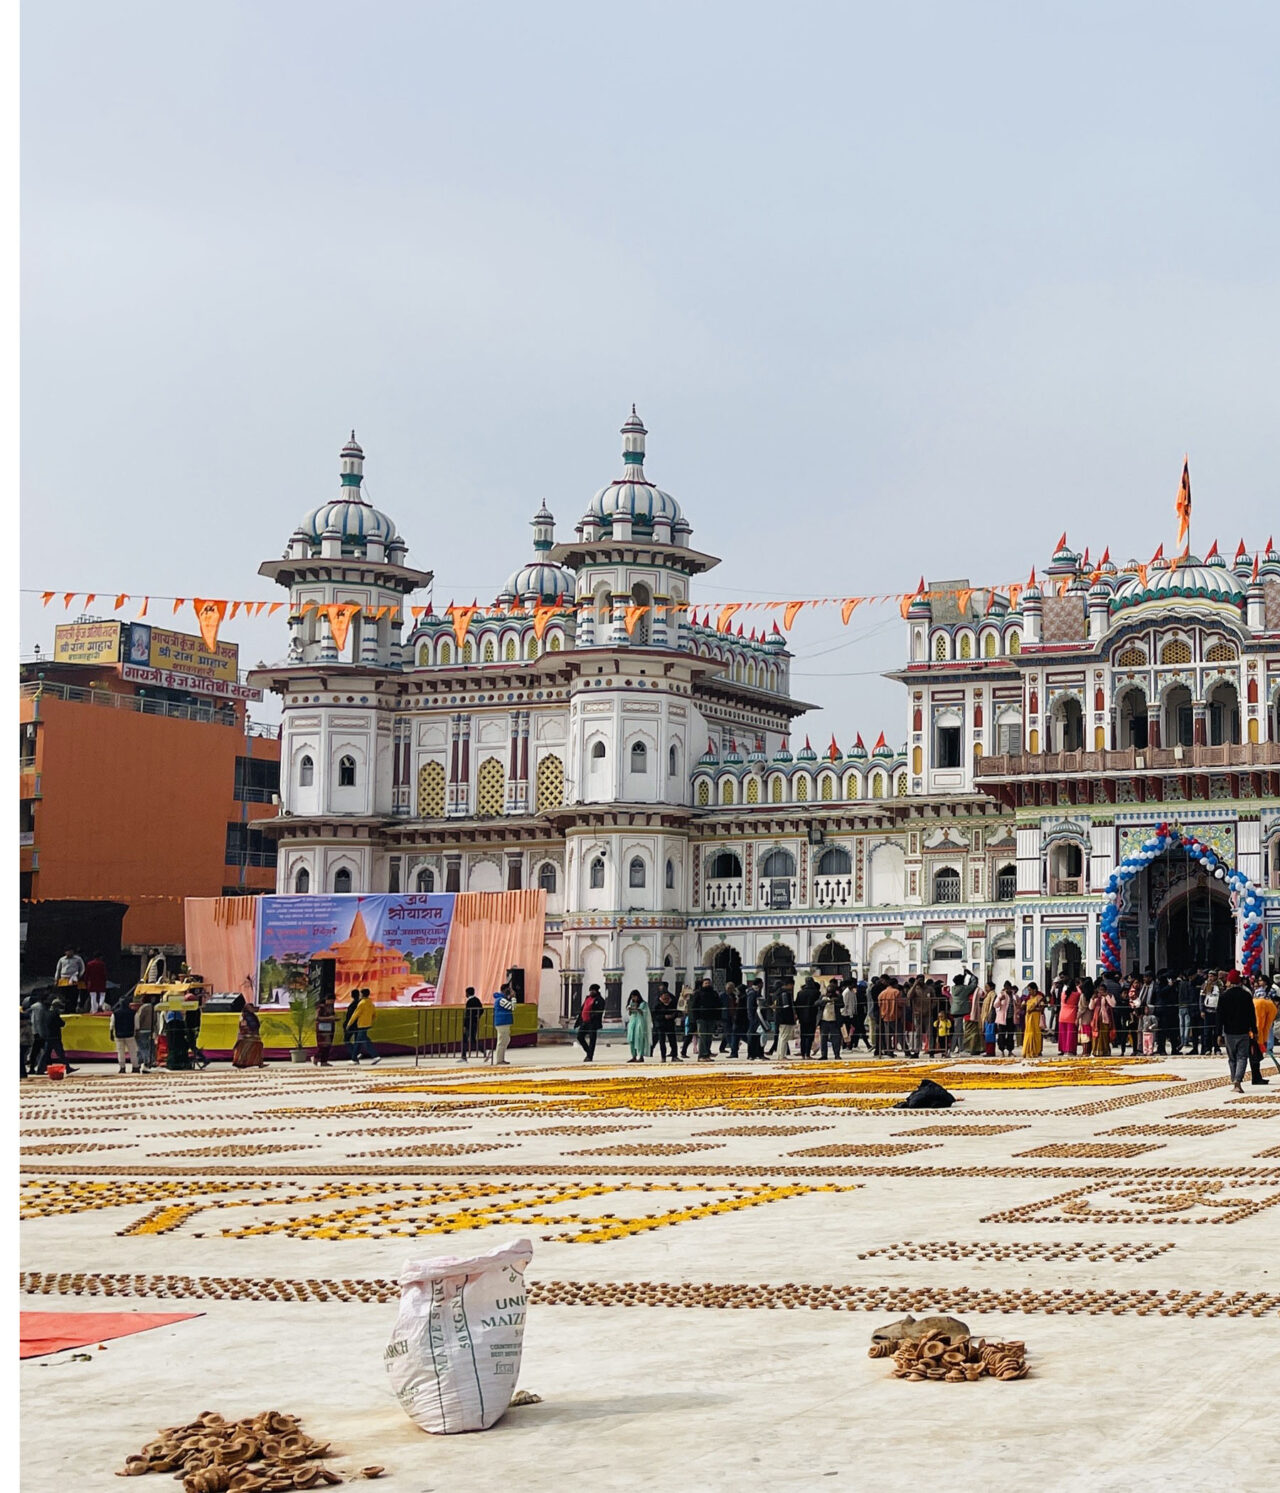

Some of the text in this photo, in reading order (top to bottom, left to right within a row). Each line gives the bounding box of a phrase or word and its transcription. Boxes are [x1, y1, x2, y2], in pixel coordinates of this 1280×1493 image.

[173, 651, 193, 662] राम
[124, 666, 163, 683] गायत्री
[403, 895, 428, 905] जय
[431, 1278, 449, 1373] MAIZE STARC
[384, 1339, 409, 1360] ARCH
